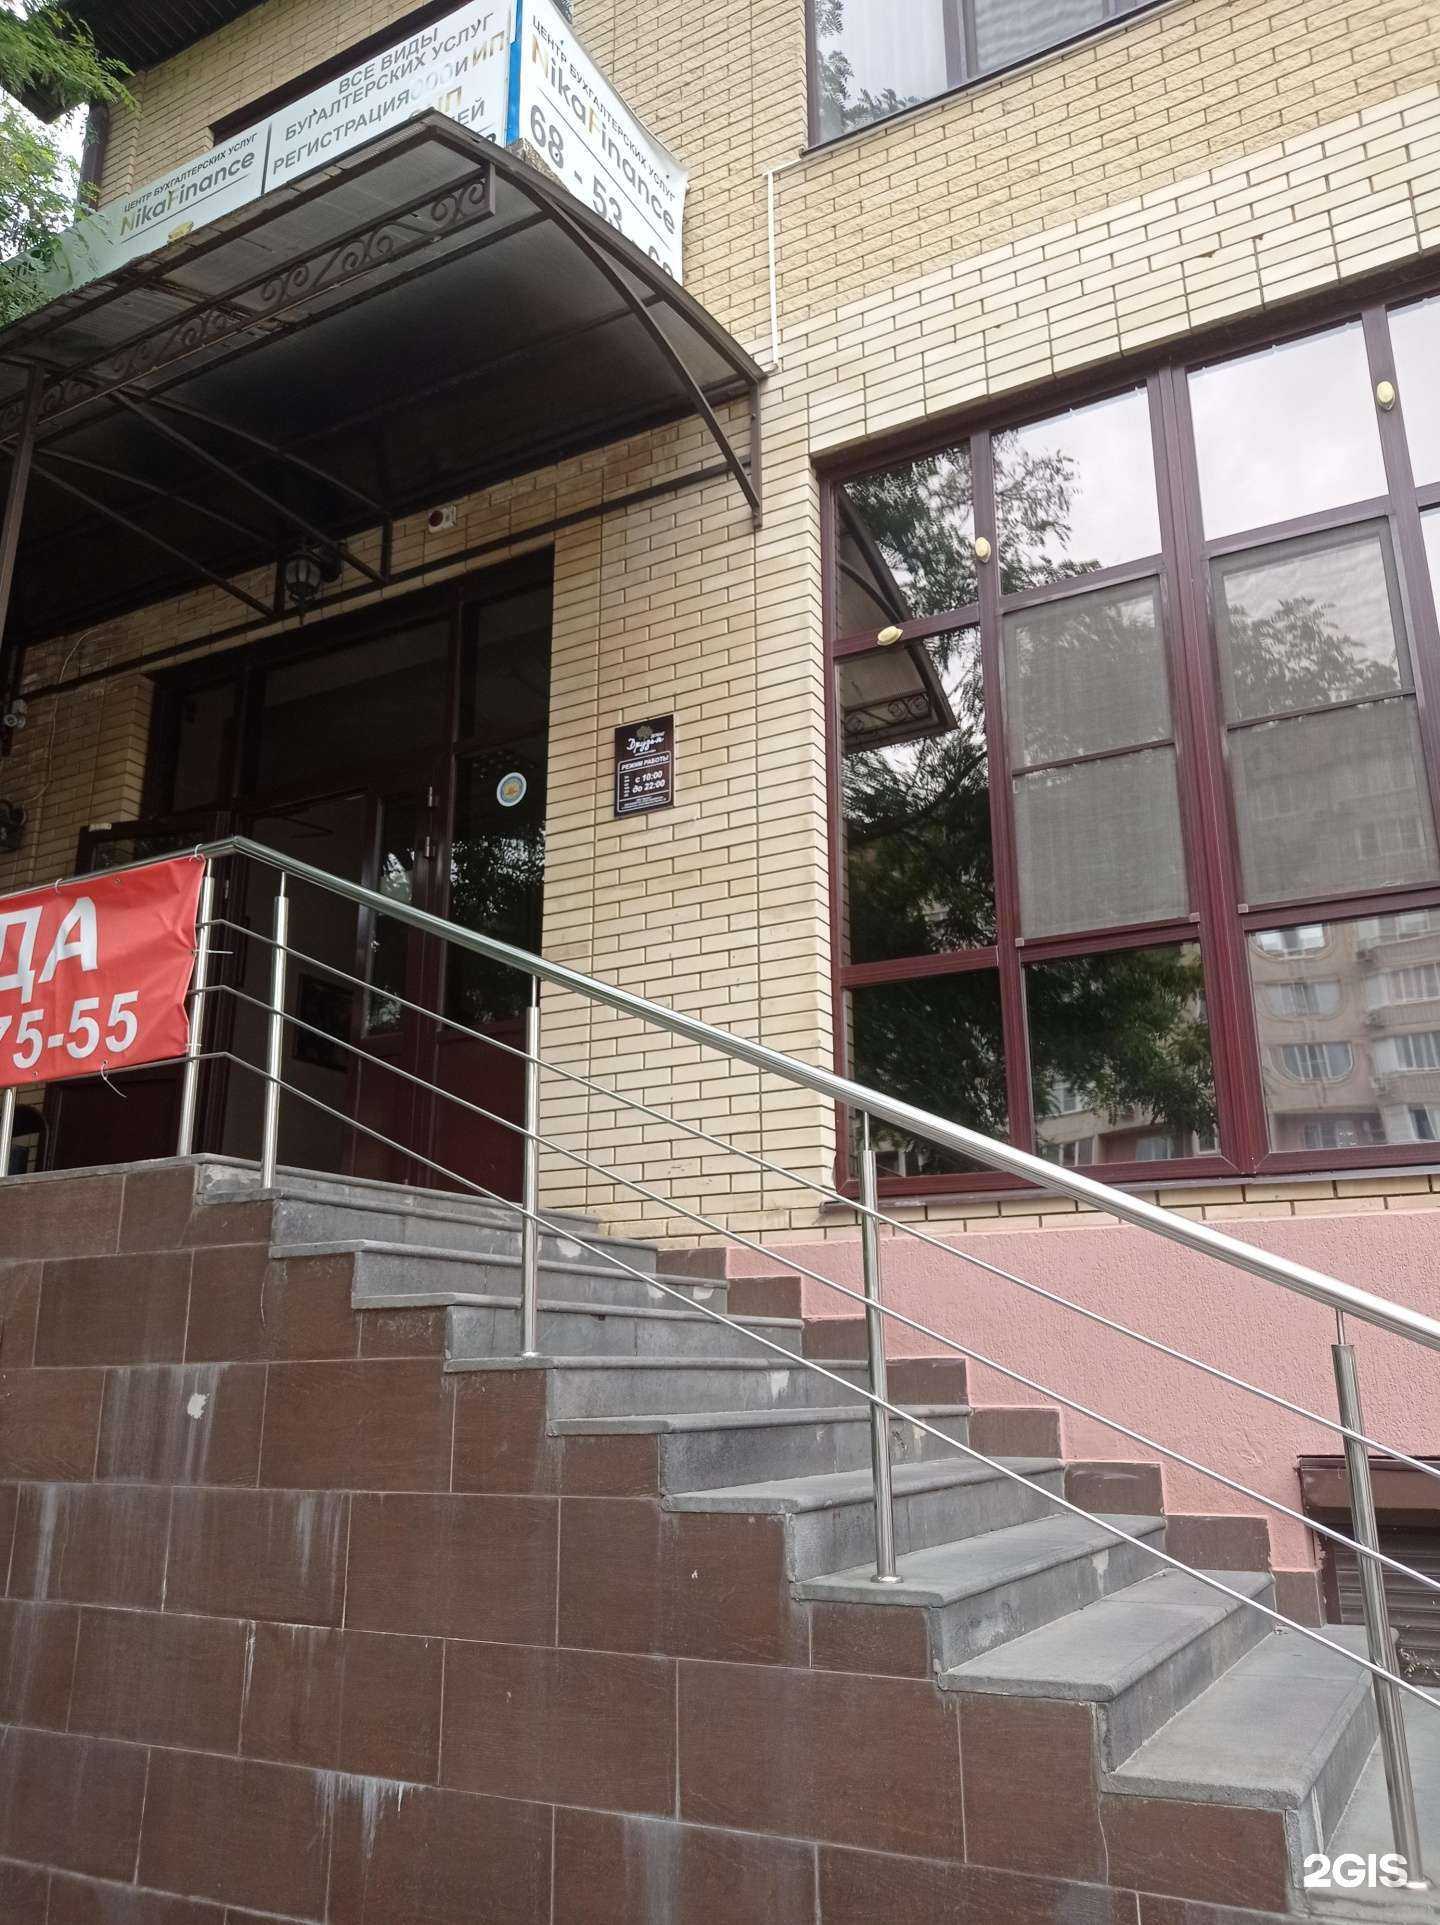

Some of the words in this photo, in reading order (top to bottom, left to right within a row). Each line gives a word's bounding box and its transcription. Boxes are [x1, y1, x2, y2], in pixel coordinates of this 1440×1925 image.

[338, 62, 376, 95] ВСЕ
[380, 27, 439, 73] ВИДЫ
[431, 12, 495, 61] УСЛУГ
[273, 88, 411, 175] РЕГИСТРАЦИЯ
[455, 56, 468, 77] И
[472, 30, 505, 67] ИП
[530, 104, 564, 169] 68
[531, 34, 676, 235] NikaFinance
[532, 15, 567, 63] ЦЕНТР
[569, 63, 647, 169] БУХГАЛТЕРСКИХ
[648, 163, 676, 202] УСЛУГ
[120, 151, 256, 237] NikaFinance
[123, 191, 153, 213] ЦЕНТР
[153, 150, 227, 197] БУХГАЛТЕРСКИХ
[228, 132, 258, 156] УСЛУГ
